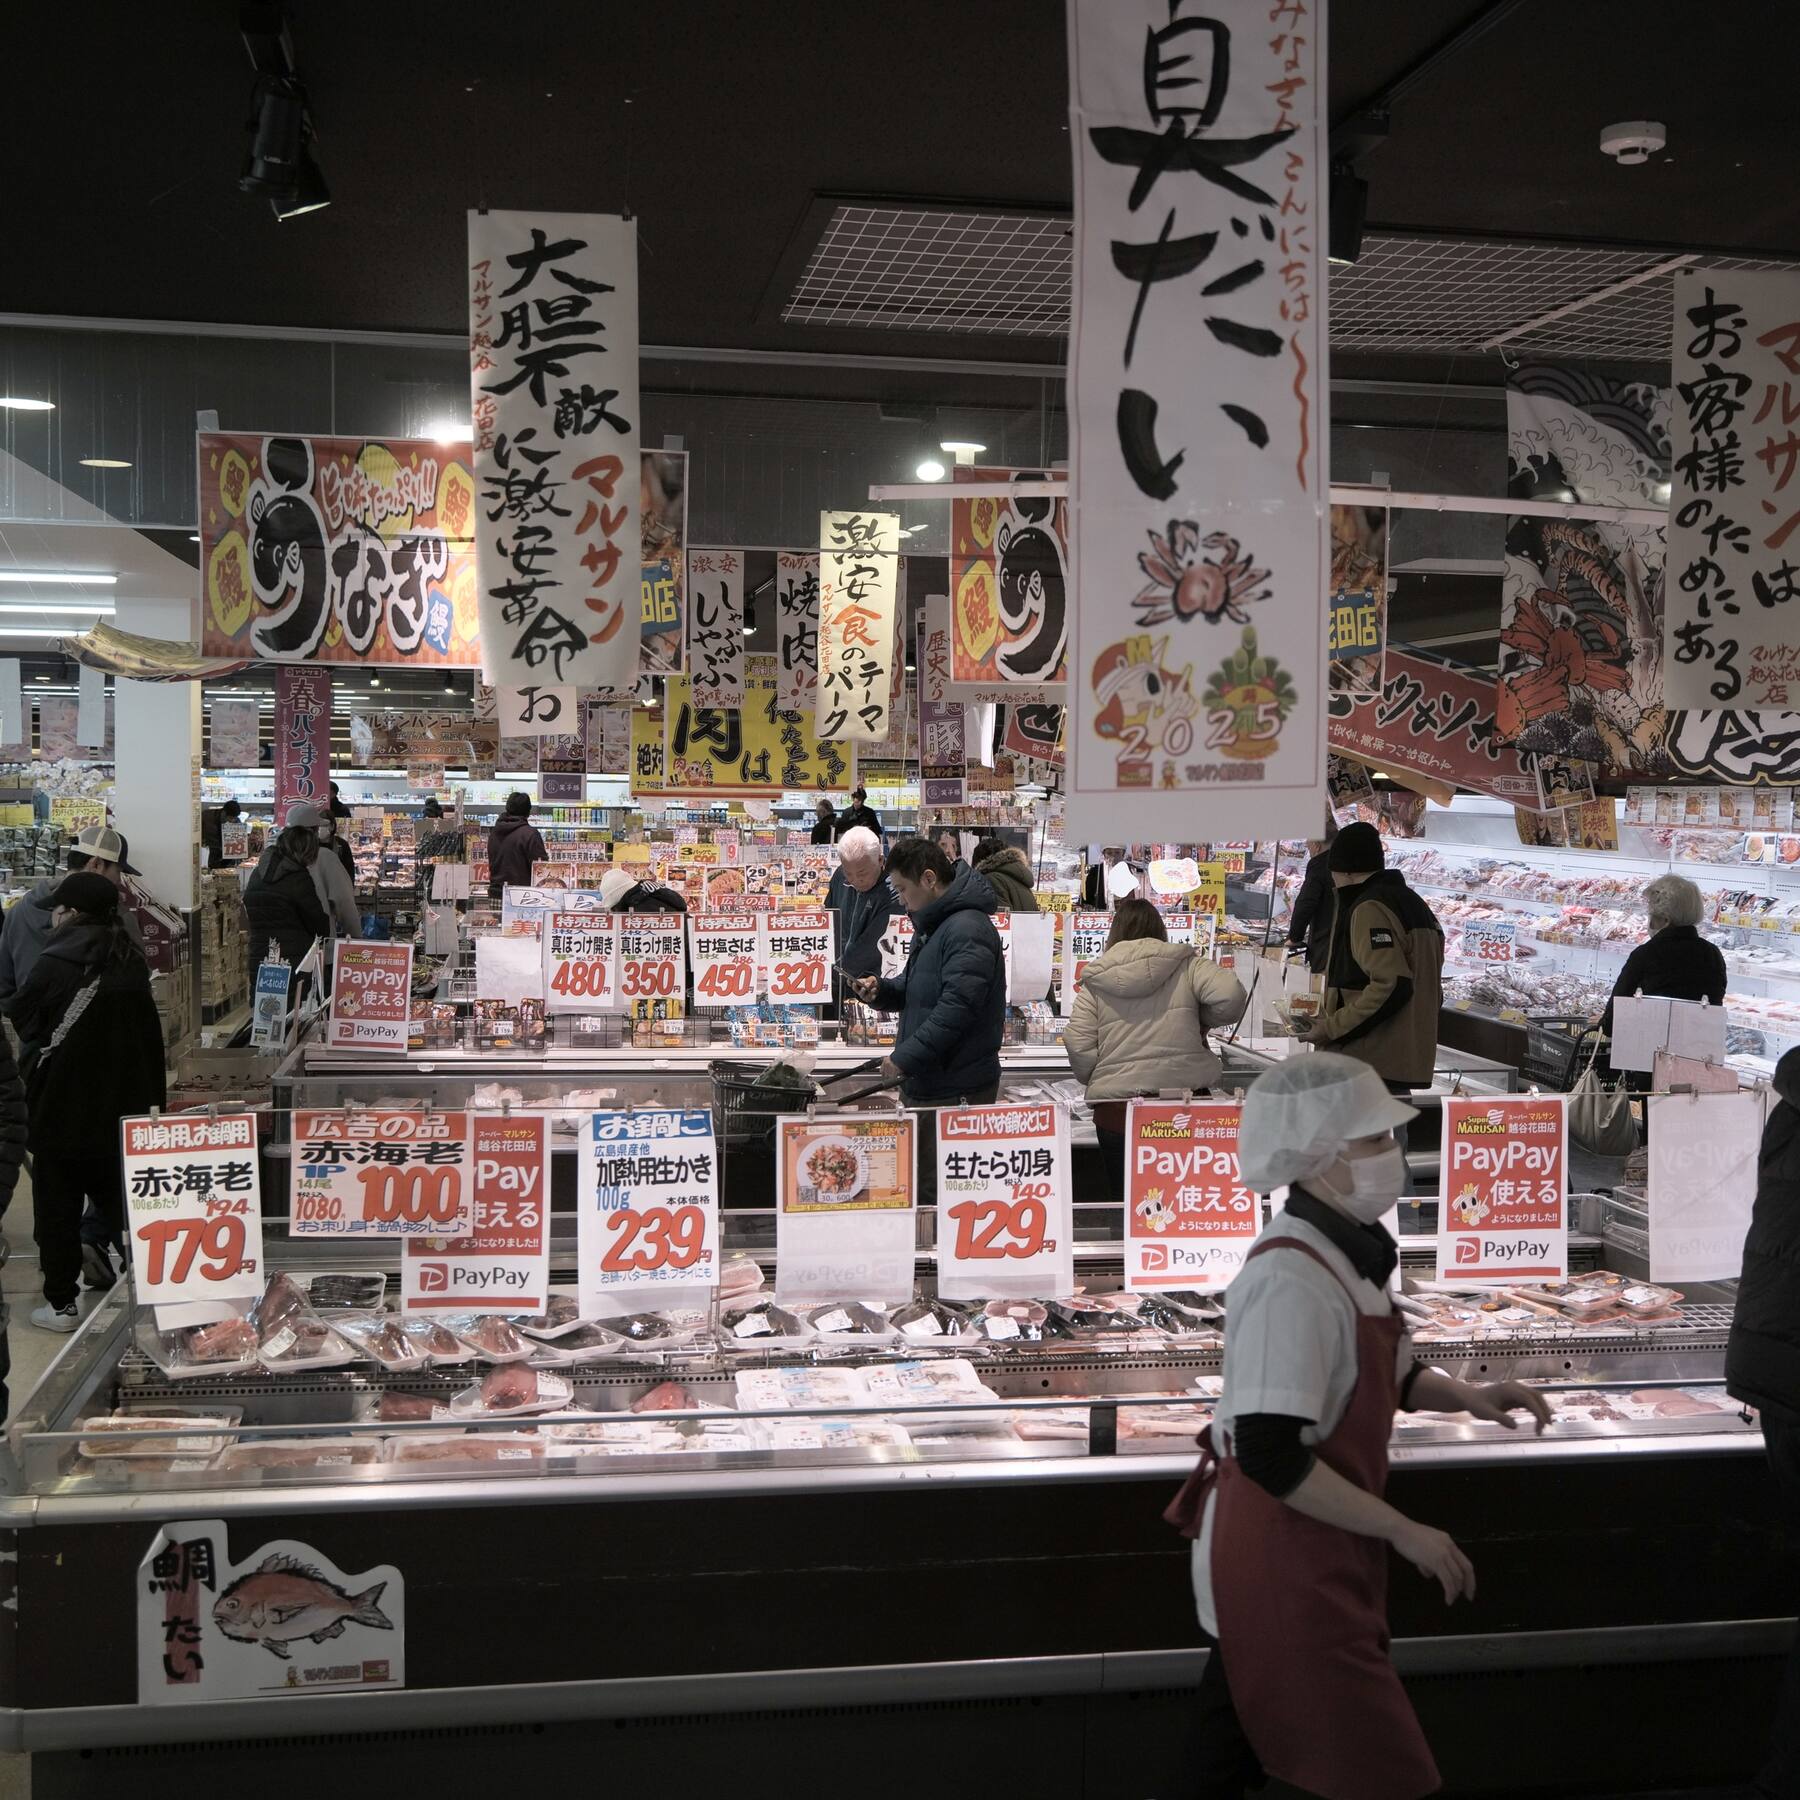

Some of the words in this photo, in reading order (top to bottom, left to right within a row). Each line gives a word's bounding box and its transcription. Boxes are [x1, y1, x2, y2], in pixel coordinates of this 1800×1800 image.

[1675, 287, 1752, 701] お客様のためにある
[571, 453, 628, 645] マルサン
[692, 553, 738, 574] 激安
[780, 571, 819, 672] 焼肉
[517, 686, 562, 724] お
[281, 678, 325, 798] 春のパンまつり
[1117, 701, 1282, 763] 2025
[740, 748, 772, 783] は
[749, 869, 767, 878] 29
[800, 871, 817, 880] 29
[557, 915, 608, 928] 特売品
[625, 915, 676, 928] 特売品
[551, 936, 613, 955] 真ほっけ開き
[621, 936, 681, 955] 真ほっけ開き
[696, 937, 755, 954] 甘塩さば
[769, 936, 828, 953] 甘塩さば
[339, 967, 406, 989] PayPay
[361, 990, 405, 1007] 使える
[356, 1024, 398, 1039] PayPay
[306, 1114, 450, 1138] 広告の品
[1217, 1117, 1242, 1126] マルサ
[1529, 1112, 1556, 1121] マルサン
[503, 1130, 535, 1138] マルサン
[598, 1113, 708, 1140] お鍋に
[1140, 1125, 1191, 1138] MARUSAN
[1194, 1127, 1241, 1139] 越谷花田
[1456, 1121, 1506, 1134] MARUSAN
[1508, 1122, 1557, 1134] 越谷花田店
[300, 1141, 465, 1165] 赤海老
[477, 1140, 537, 1152] 越谷花田店
[594, 1143, 650, 1158] 広島県産他
[945, 1148, 1054, 1180] 生たら切身
[1453, 1141, 1559, 1177] PayPay
[131, 1161, 253, 1197] 赤海老
[597, 1154, 712, 1187] 加熱用生かき
[944, 1179, 989, 1191] 100gあたり
[1490, 1179, 1558, 1206] 使える
[131, 1199, 180, 1210] 100gあたり
[595, 1186, 631, 1211] 100g
[666, 1195, 711, 1206] 本体価格
[1175, 1185, 1251, 1213] 使える
[1491, 1212, 1558, 1224] ようになりました!!
[460, 1237, 539, 1249] ようになりました!!
[1484, 1240, 1550, 1262] PayPay
[453, 1268, 530, 1289] PayPay
[161, 1615, 204, 1680] たい
